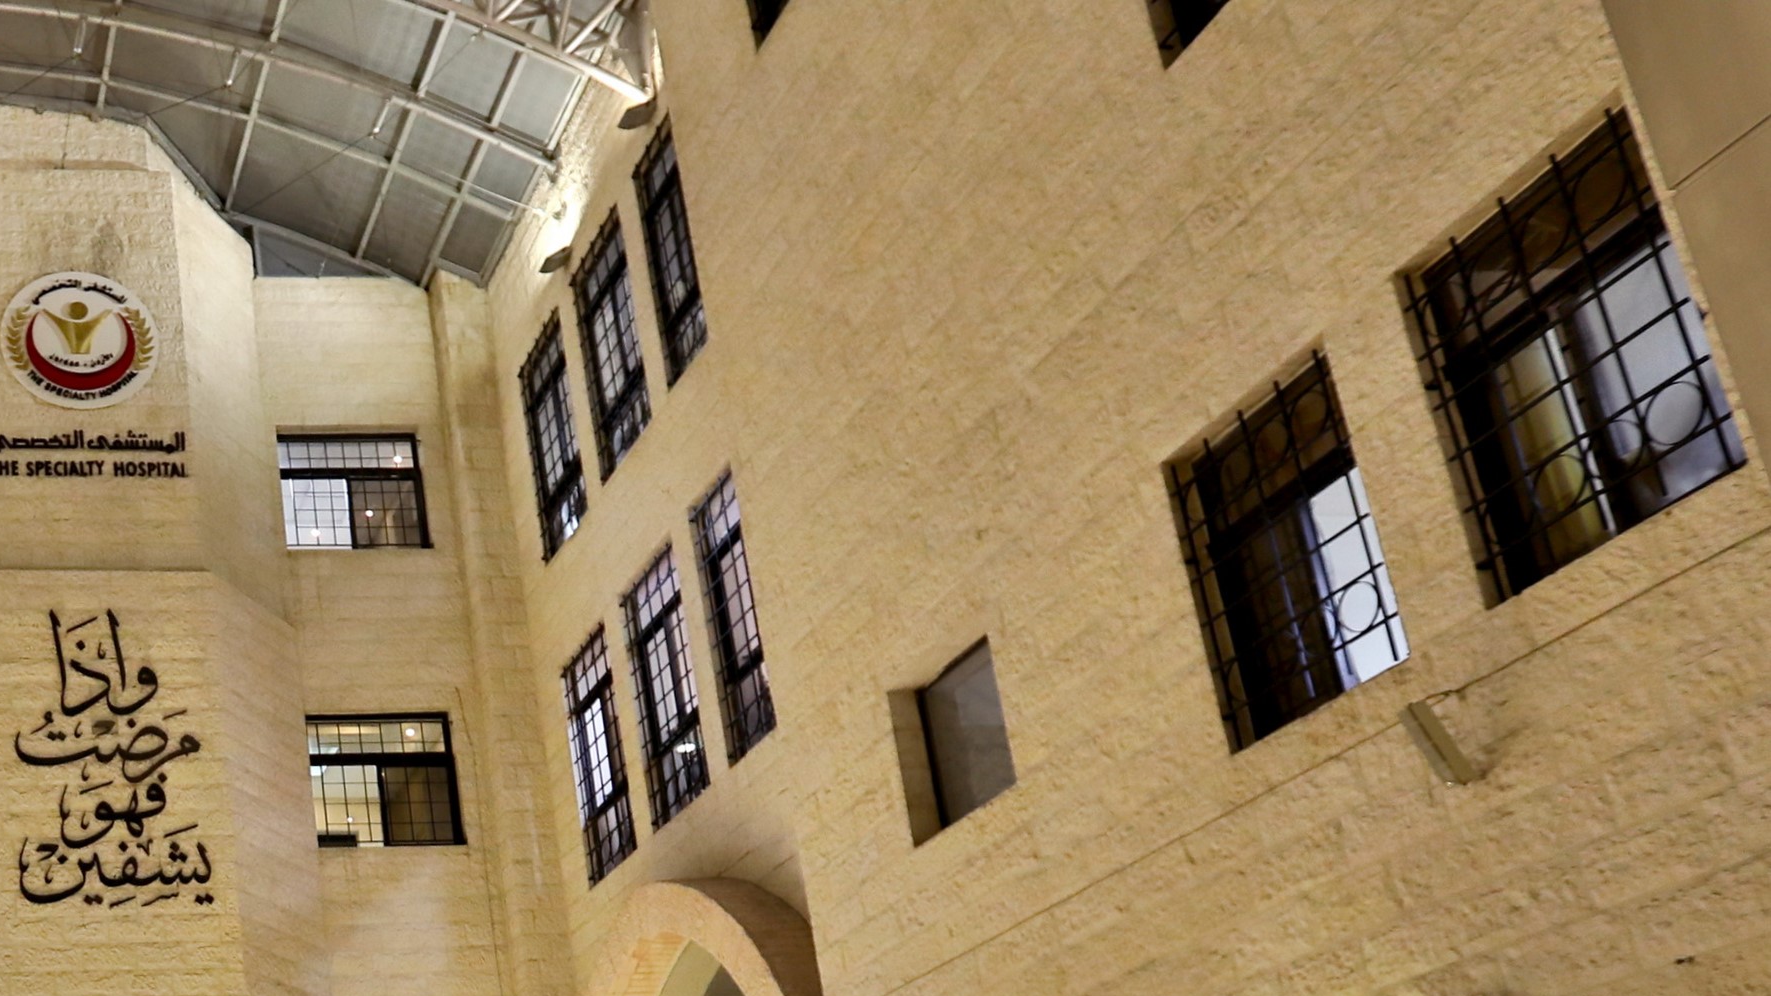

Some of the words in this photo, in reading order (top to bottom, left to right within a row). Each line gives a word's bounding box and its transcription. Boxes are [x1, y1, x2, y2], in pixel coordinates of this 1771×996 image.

[27, 369, 45, 386] THE
[43, 381, 97, 401] SPECIALTY
[98, 370, 139, 398] HOSPITAL
[86, 429, 186, 455] المستشفى
[25, 459, 105, 478] SPECIALTY
[113, 460, 189, 478] HOSPITAL
